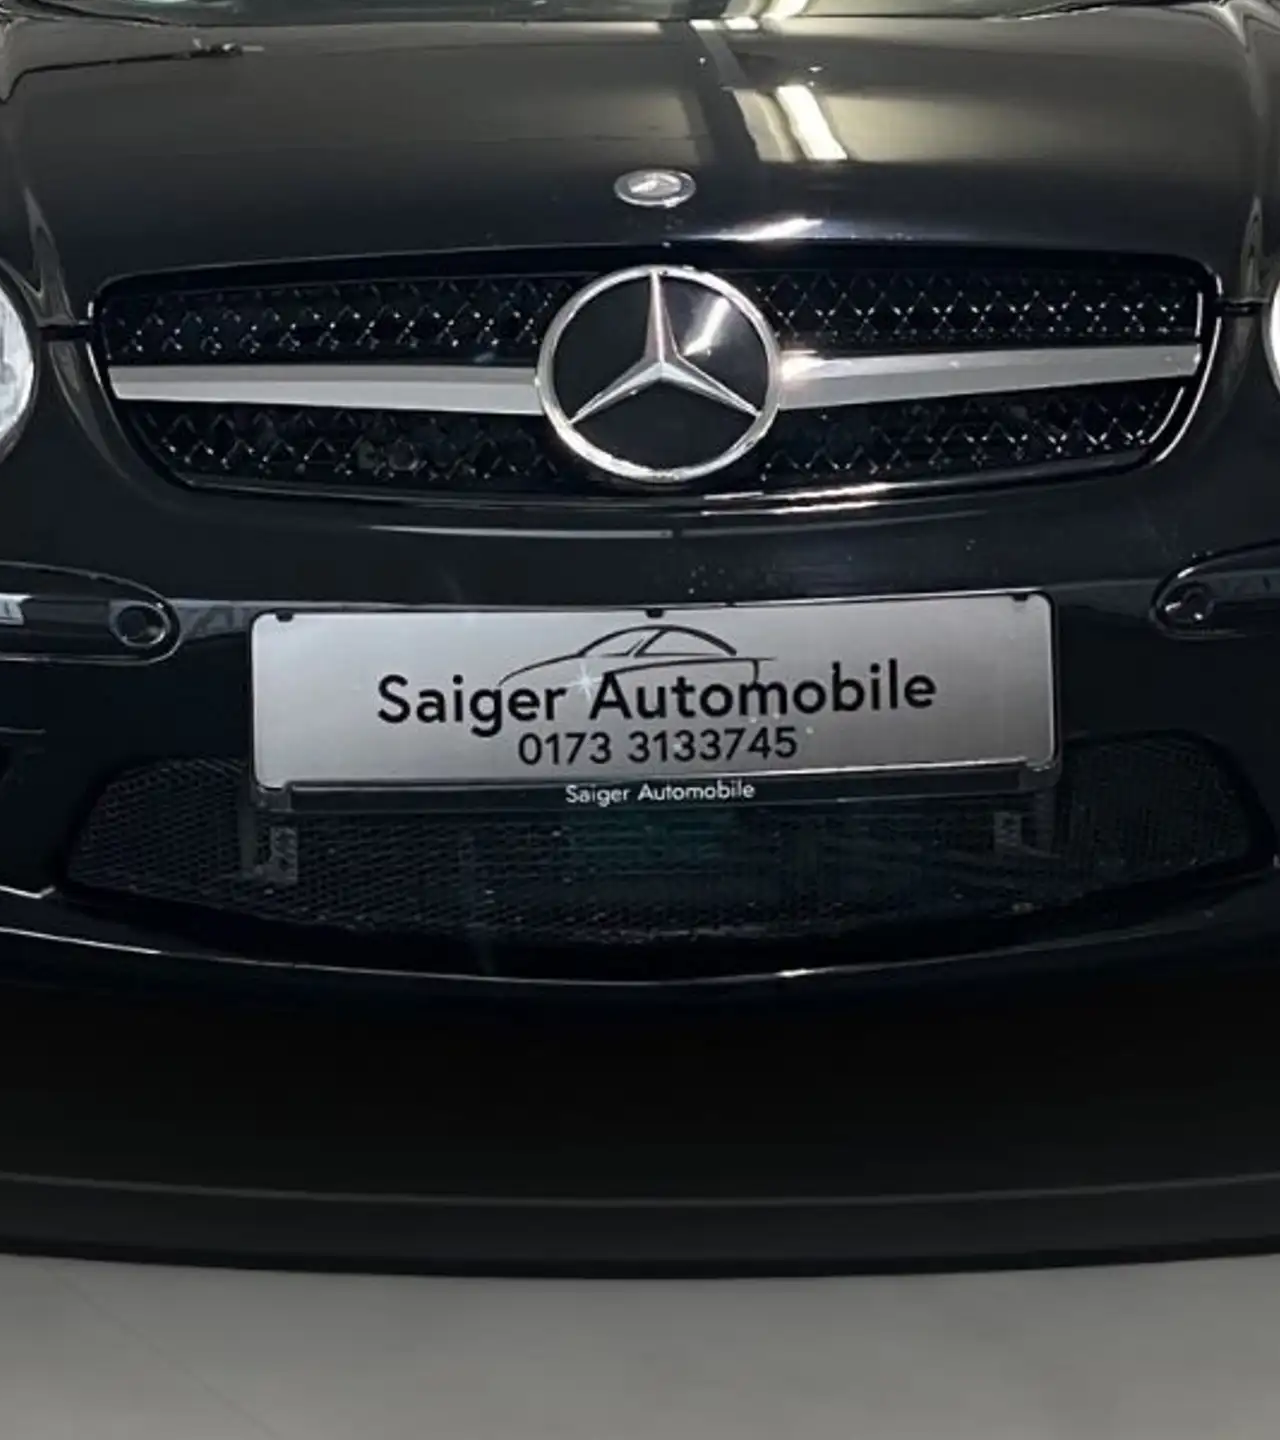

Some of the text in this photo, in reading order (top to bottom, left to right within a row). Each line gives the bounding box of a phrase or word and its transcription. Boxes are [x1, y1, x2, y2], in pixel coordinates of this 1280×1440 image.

[377, 660, 936, 737] Saiger Automobile
[518, 726, 798, 766] 0173 3133745
[565, 779, 756, 807] Saiger Automobile
